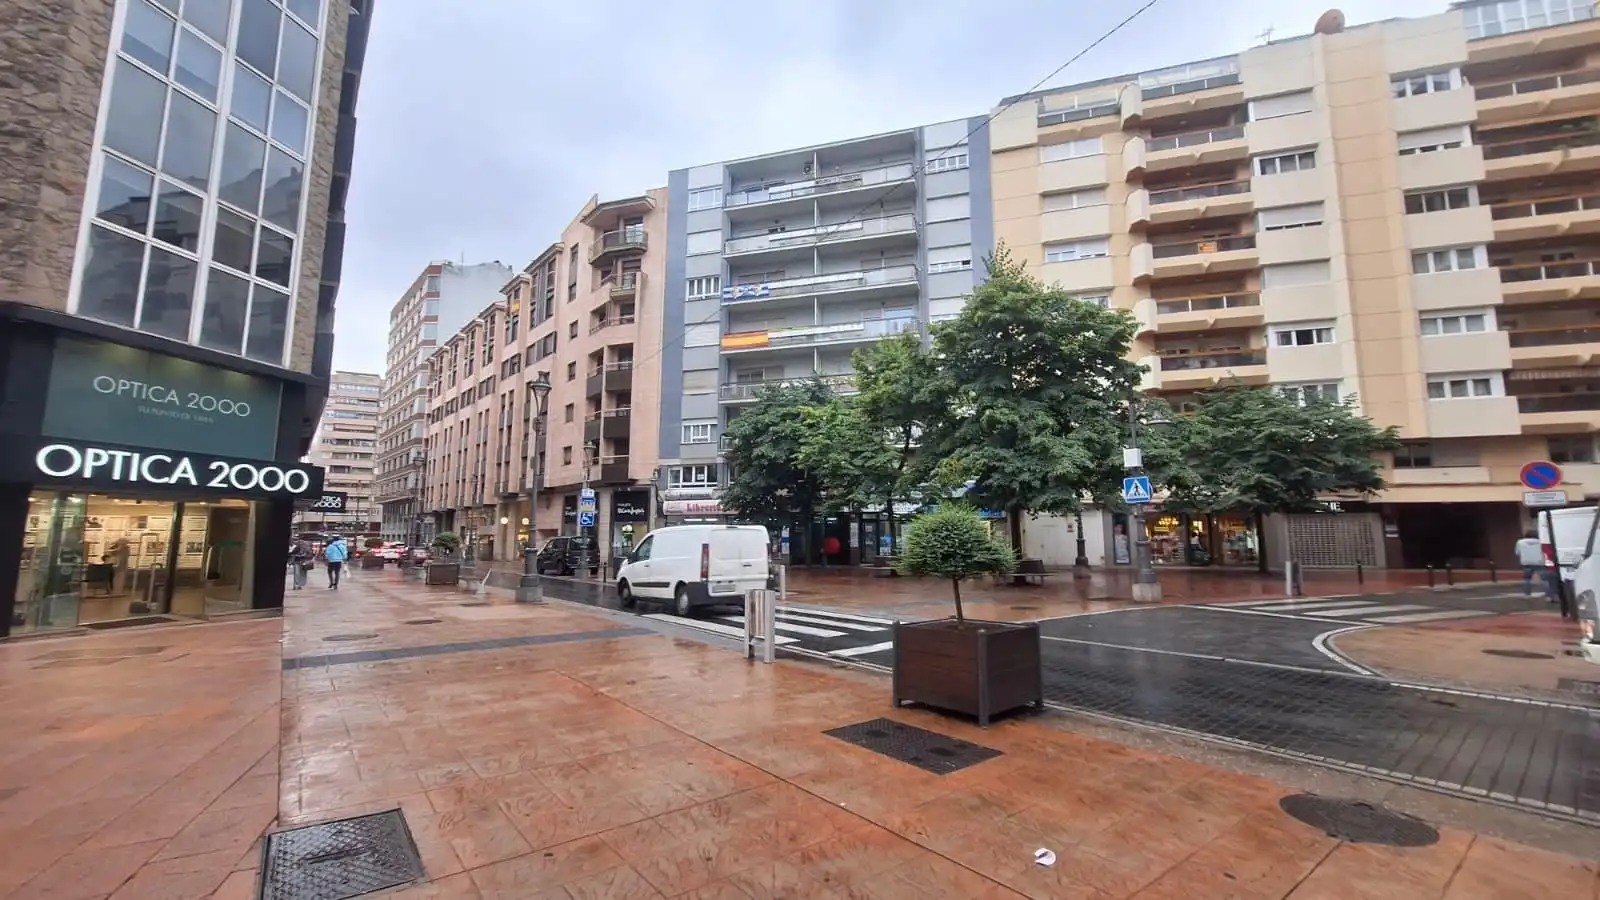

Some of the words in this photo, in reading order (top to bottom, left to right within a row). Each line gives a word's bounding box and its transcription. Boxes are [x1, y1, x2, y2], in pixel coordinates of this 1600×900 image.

[93, 376, 180, 406] OPTICA
[187, 392, 251, 417] 2000
[35, 443, 198, 486] OPTICA
[207, 461, 310, 494] 2000
